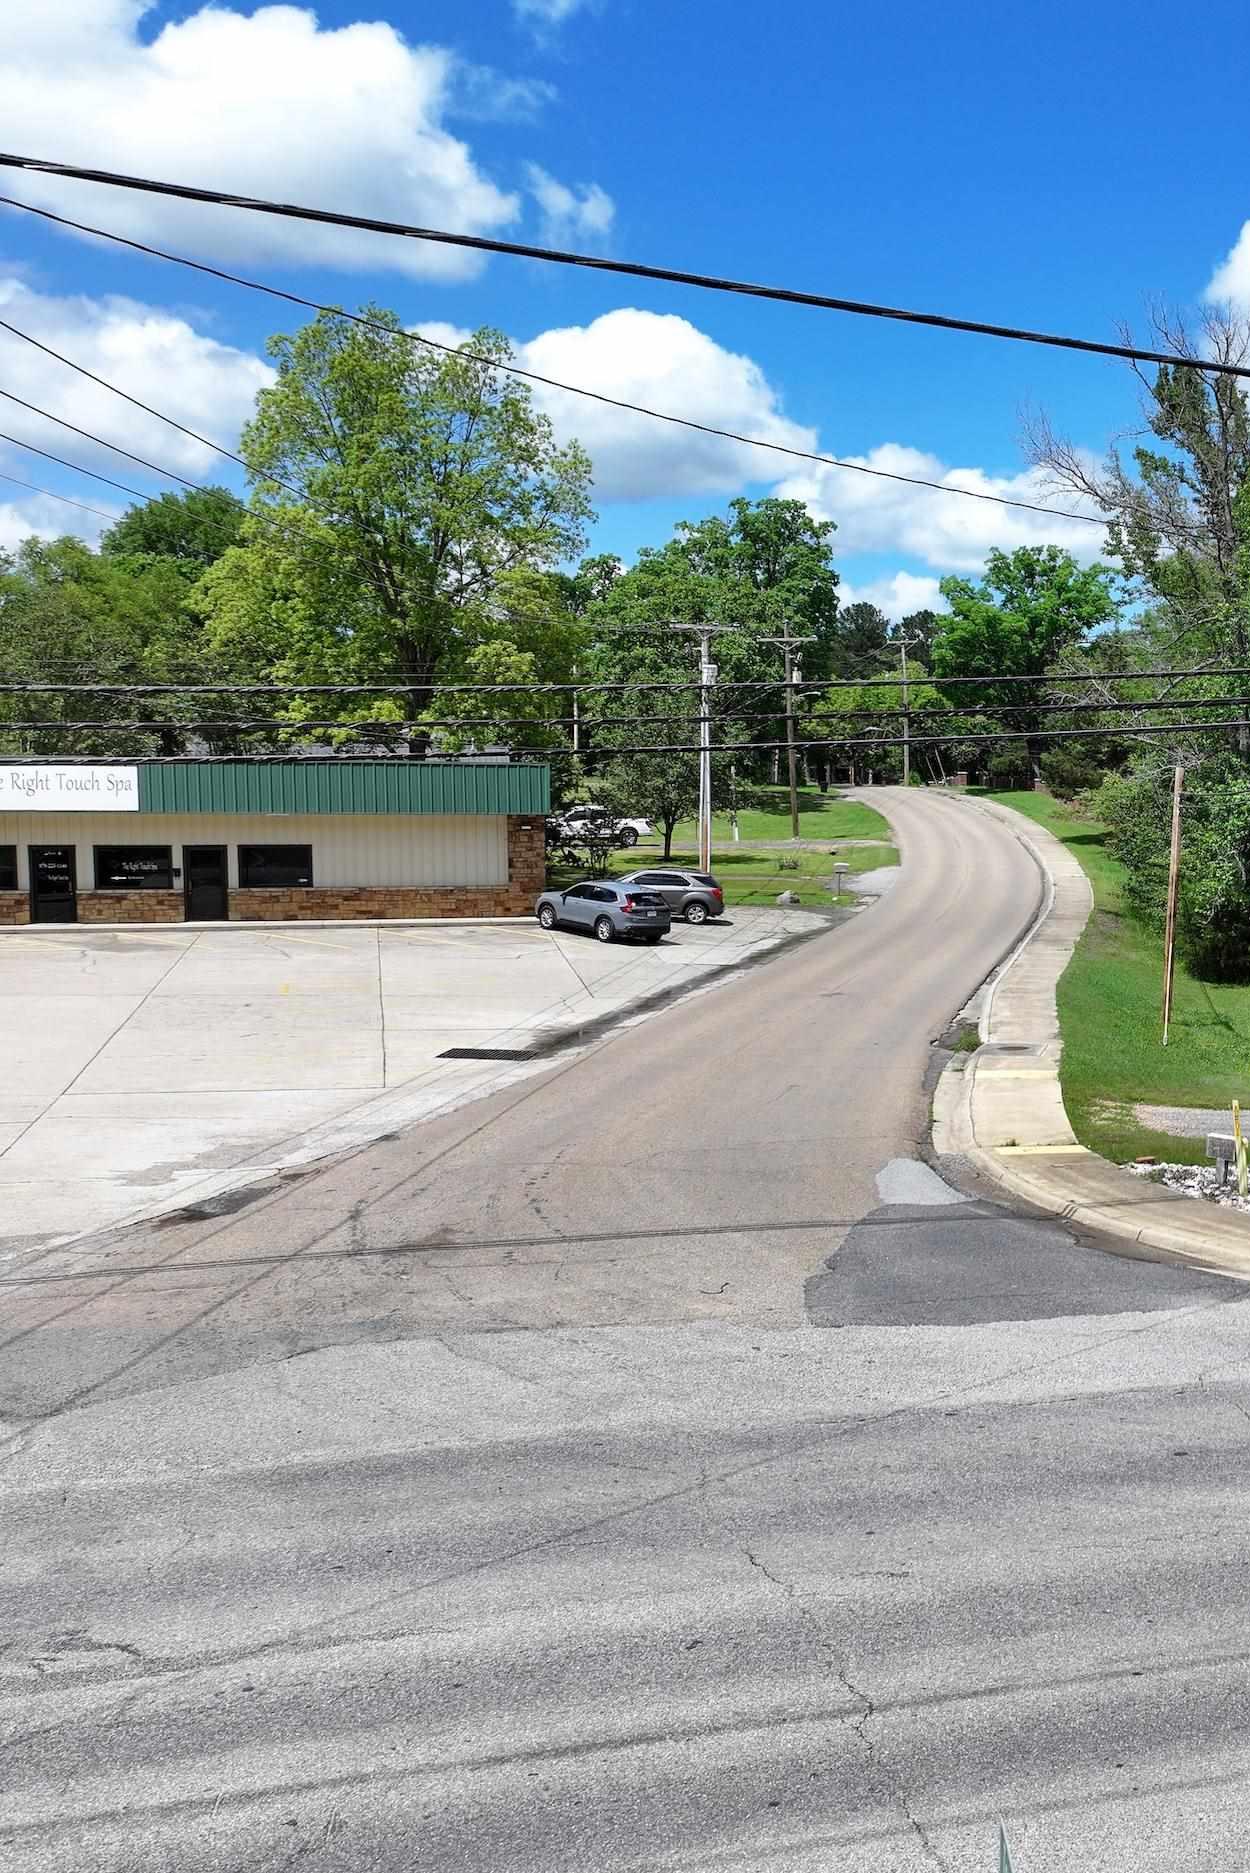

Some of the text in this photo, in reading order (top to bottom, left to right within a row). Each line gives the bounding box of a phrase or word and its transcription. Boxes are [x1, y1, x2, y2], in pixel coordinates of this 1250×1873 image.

[10, 770, 51, 797] Right
[55, 770, 101, 791] Touch
[105, 773, 133, 800] Spa
